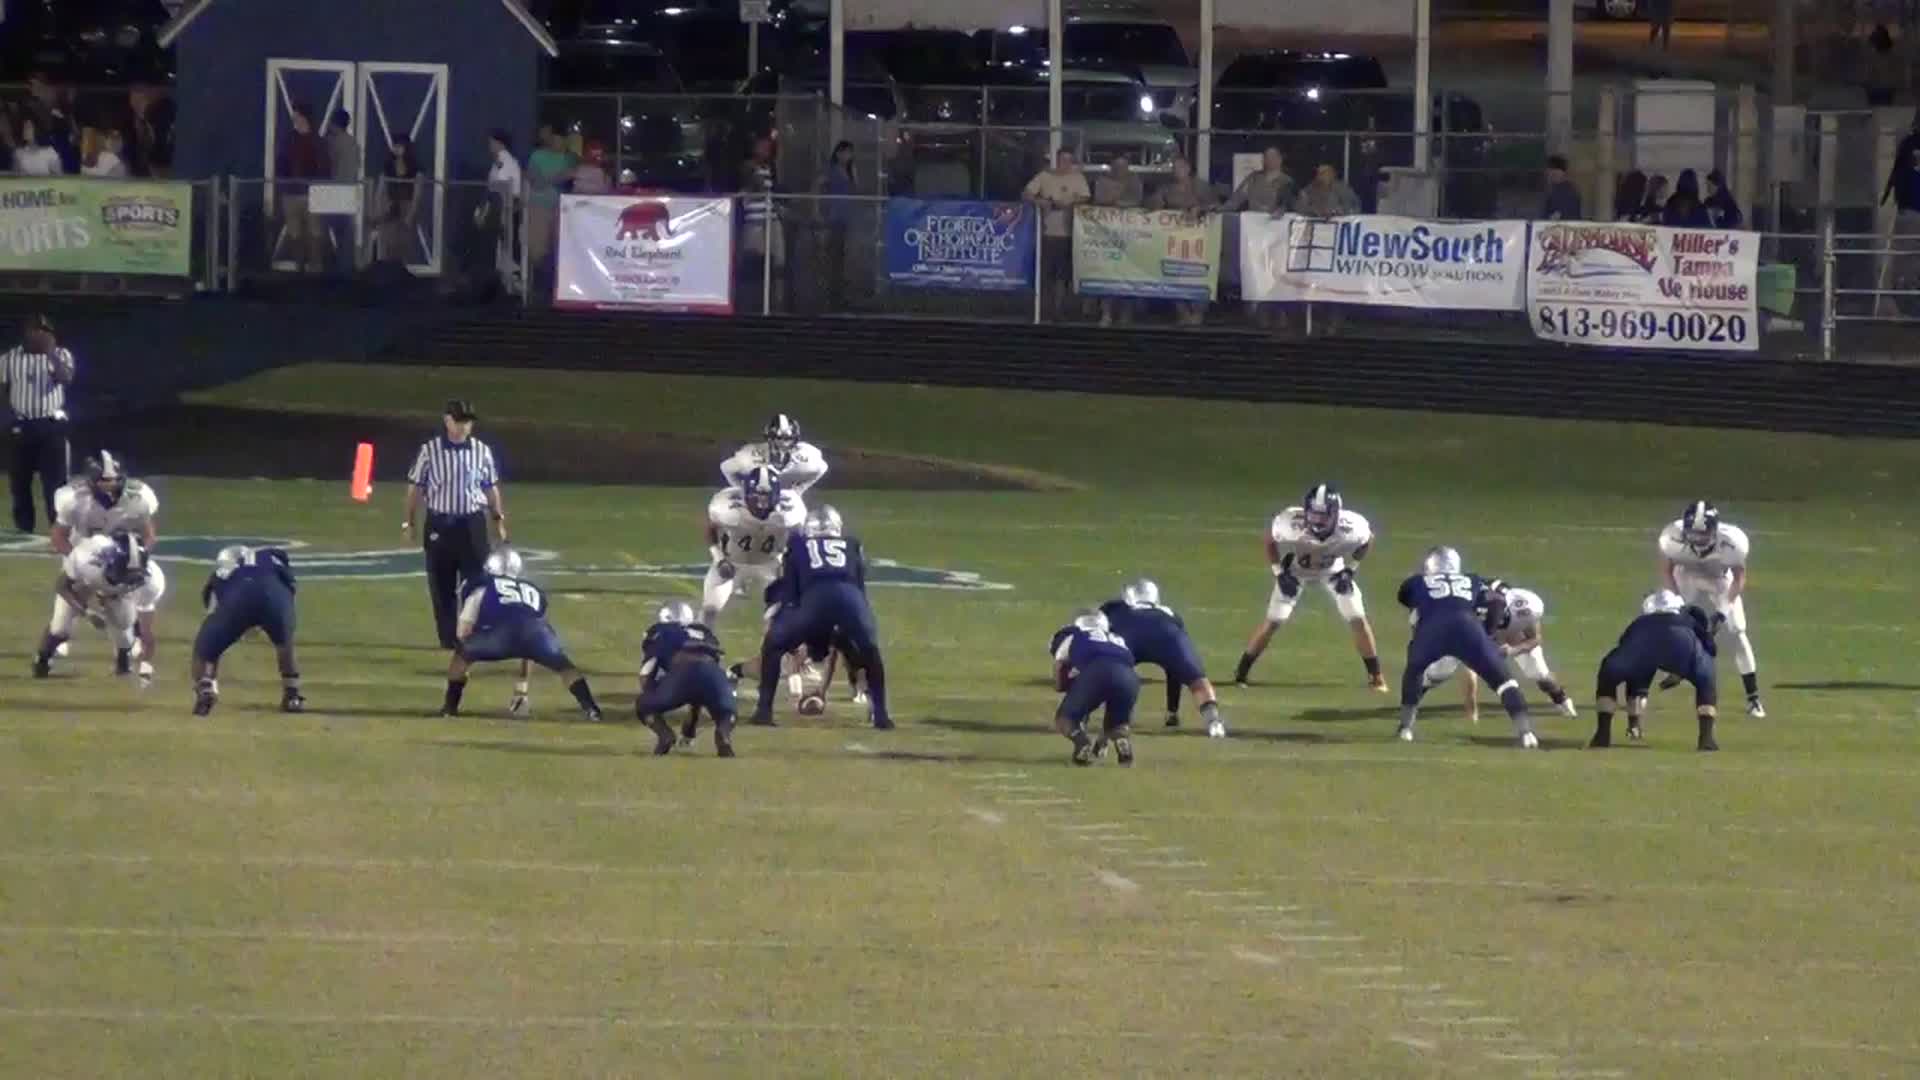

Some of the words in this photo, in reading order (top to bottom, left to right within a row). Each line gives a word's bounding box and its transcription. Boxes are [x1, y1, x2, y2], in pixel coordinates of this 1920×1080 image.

[927, 215, 996, 234] FLORIDA
[918, 244, 1000, 264] INSTITUTE
[1338, 222, 1504, 264] NewSouth
[1671, 233, 1739, 254] Miller's
[1336, 258, 1429, 278] WINDOW
[1539, 305, 1747, 343] 813-969-0020
[806, 538, 848, 569] 15
[494, 578, 541, 611] 50
[1423, 574, 1473, 601] 52
